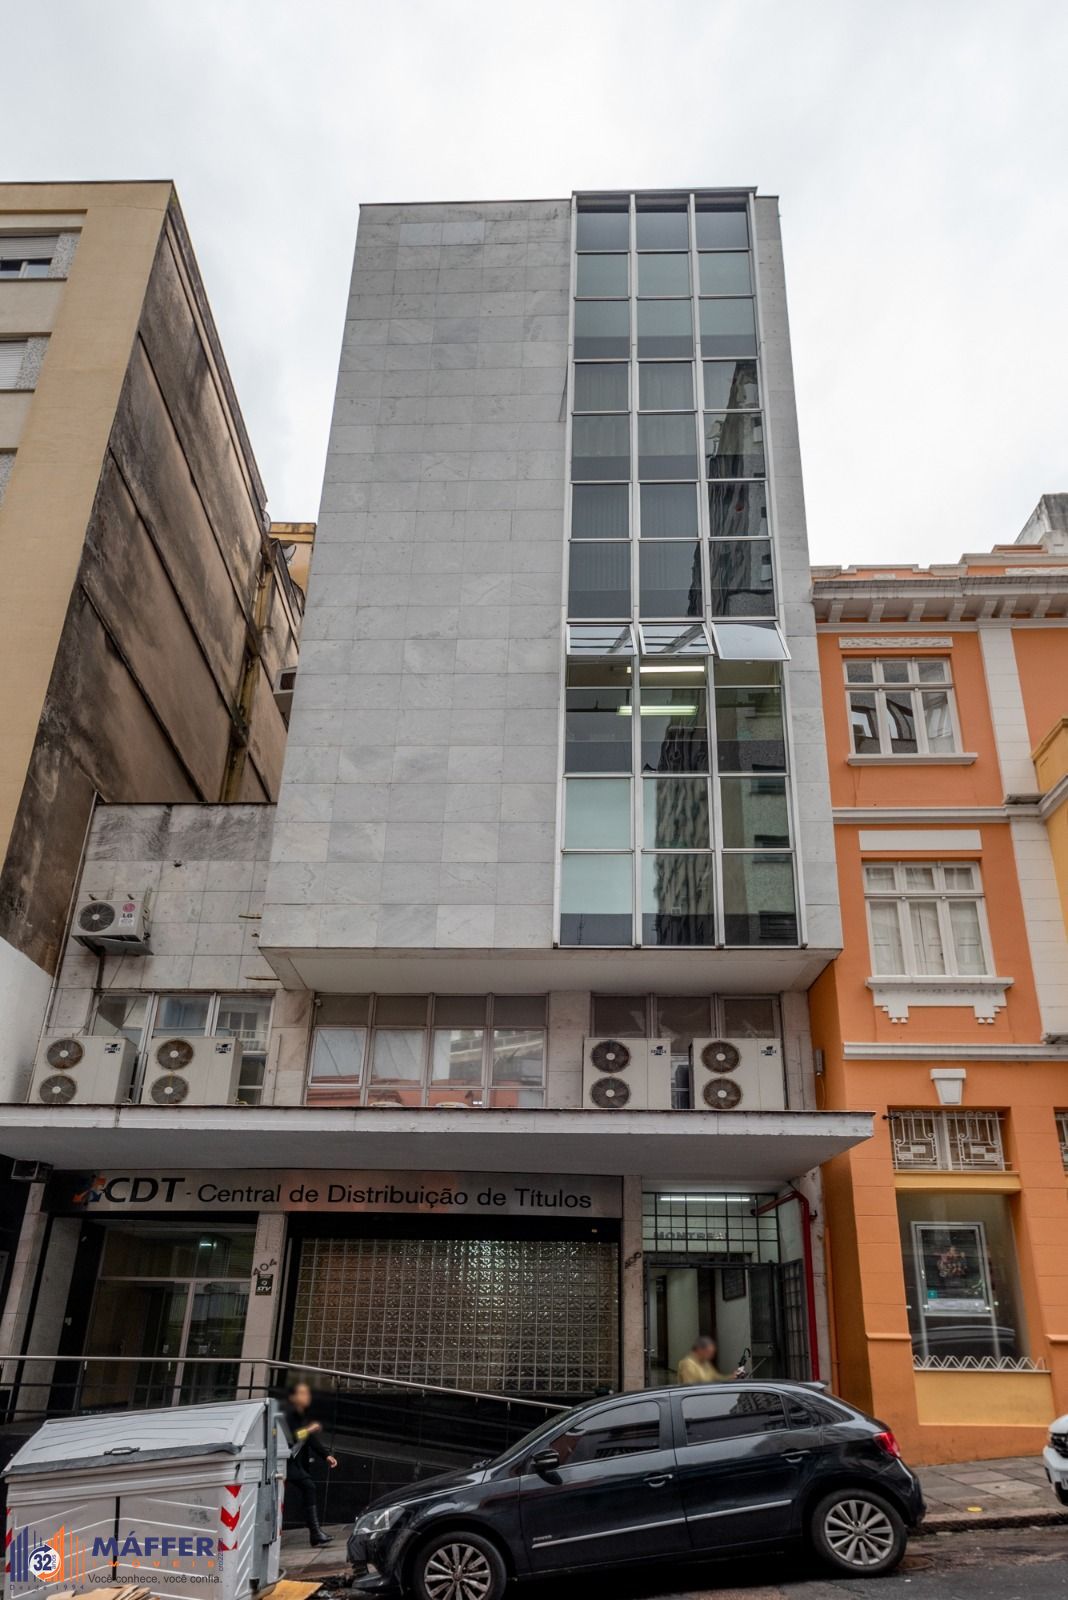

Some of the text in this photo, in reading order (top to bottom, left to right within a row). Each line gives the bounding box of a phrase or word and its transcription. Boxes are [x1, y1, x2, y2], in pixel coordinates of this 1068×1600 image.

[104, 1177, 185, 1203] CDT
[197, 1183, 282, 1203] Central
[289, 1185, 319, 1203] de
[327, 1184, 469, 1209] Distribuição
[476, 1188, 507, 1206] de
[514, 1188, 593, 1209] Títulos
